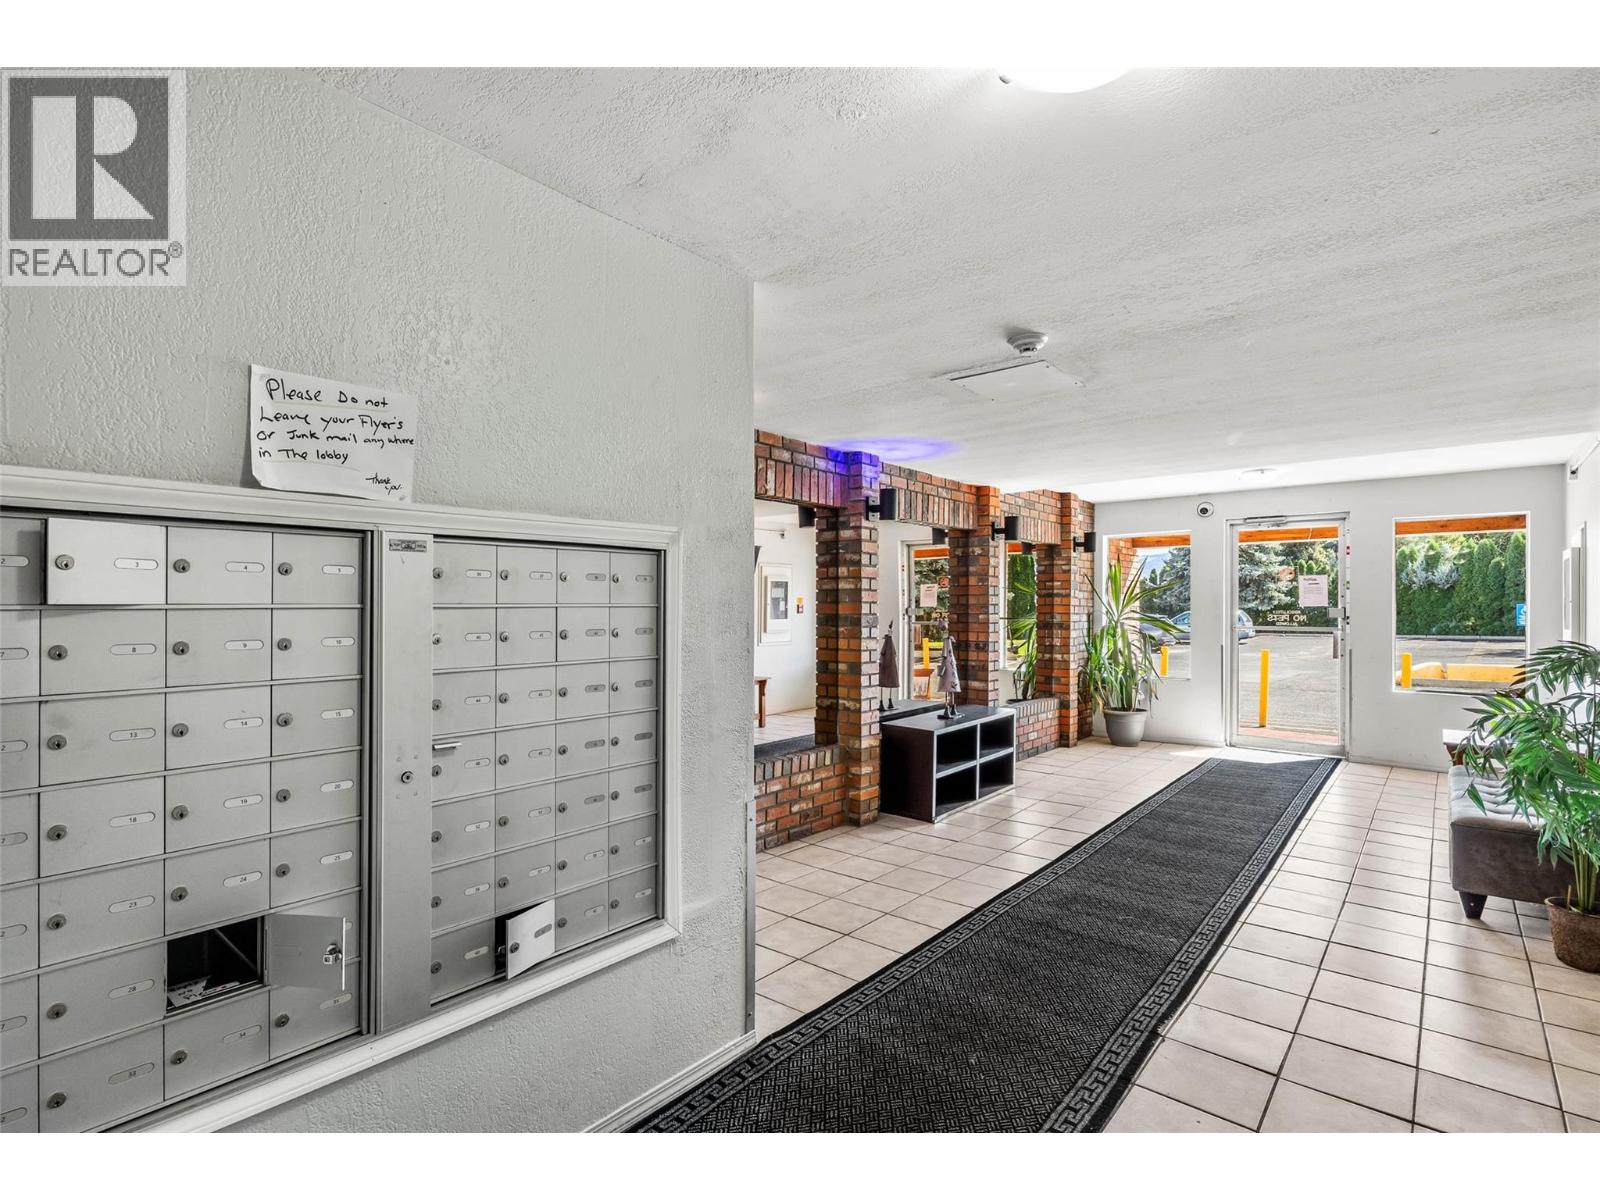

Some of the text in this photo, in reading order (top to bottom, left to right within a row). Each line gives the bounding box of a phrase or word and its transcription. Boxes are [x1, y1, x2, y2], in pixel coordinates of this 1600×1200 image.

[265, 378, 389, 407] Please Do not
[259, 406, 403, 435] Leave your Flyer's
[286, 429, 320, 440] Junk
[326, 433, 357, 444] mail
[258, 446, 349, 464] in The lobby
